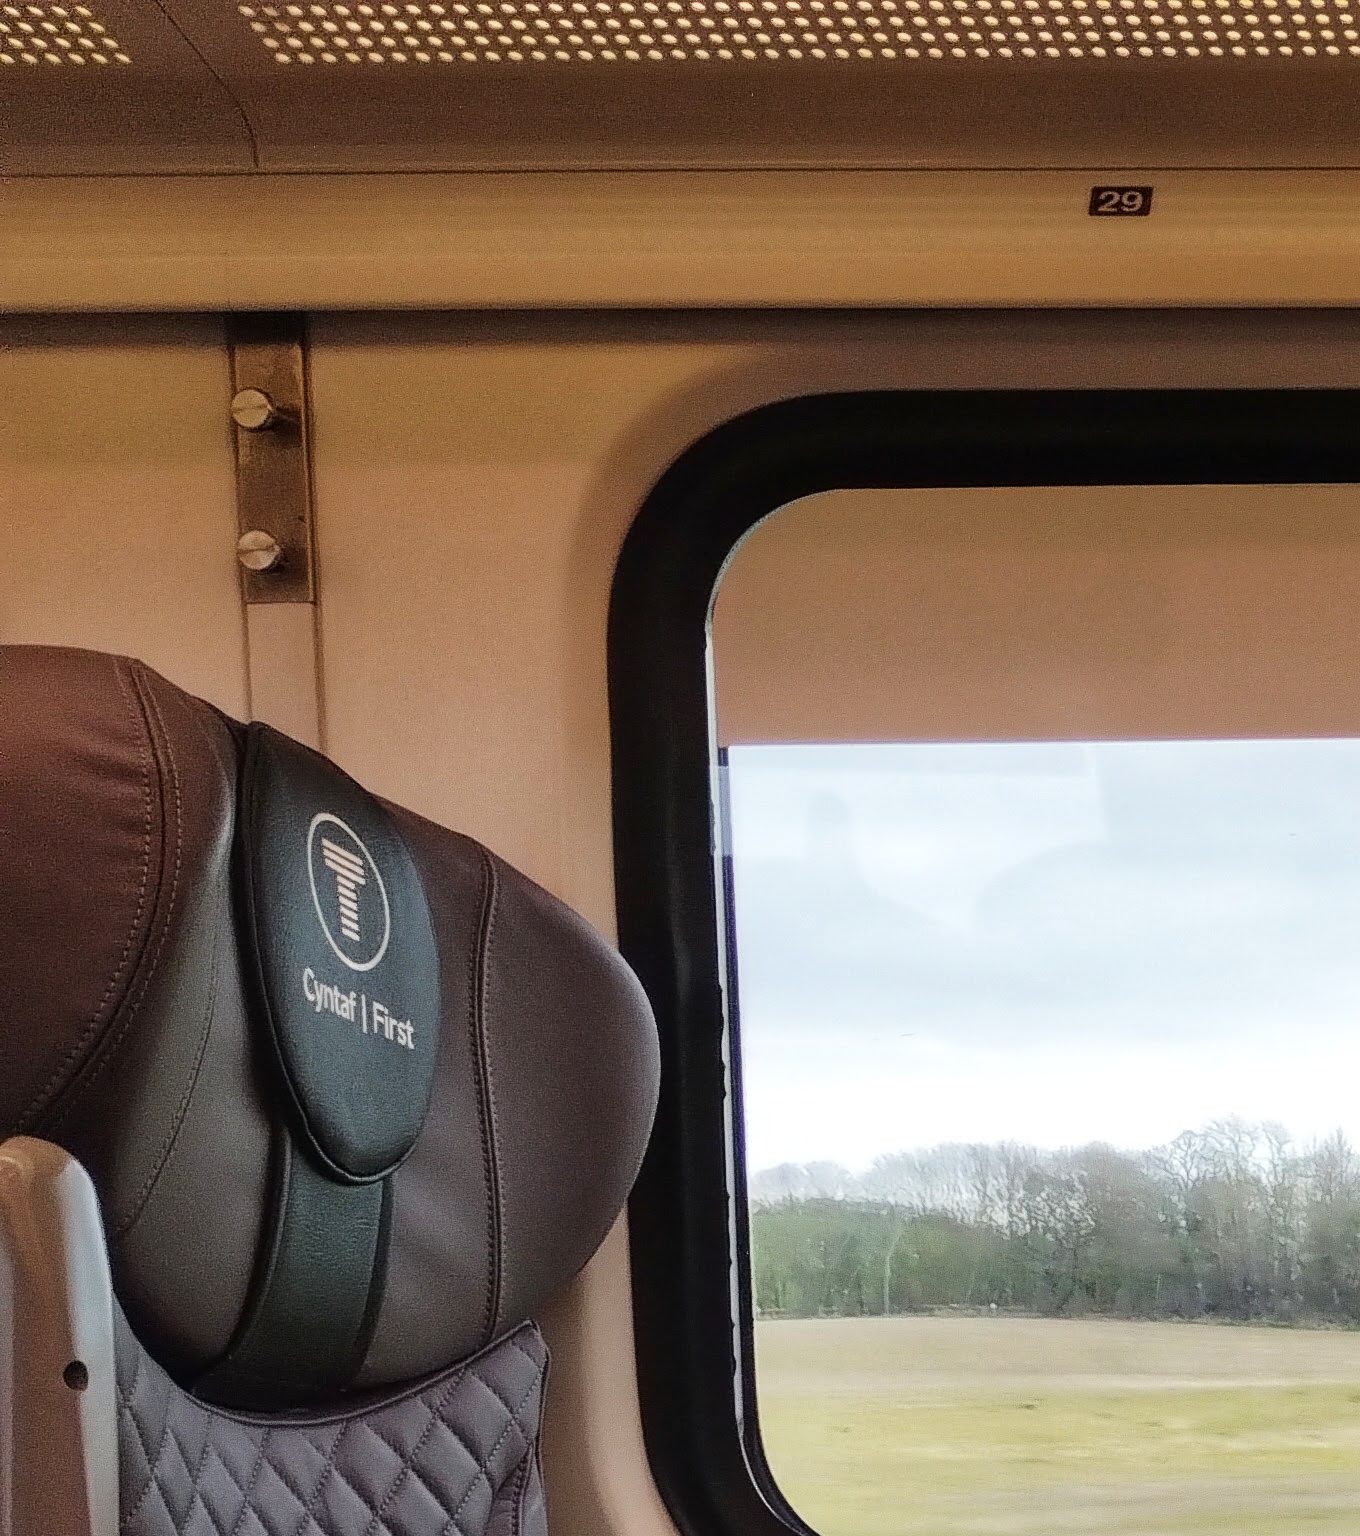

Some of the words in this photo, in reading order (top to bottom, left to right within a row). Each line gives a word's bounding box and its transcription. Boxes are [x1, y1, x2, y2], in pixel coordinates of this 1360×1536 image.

[1098, 190, 1144, 212] 29
[302, 966, 356, 1022] Cyntaf
[371, 1001, 416, 1051] First
